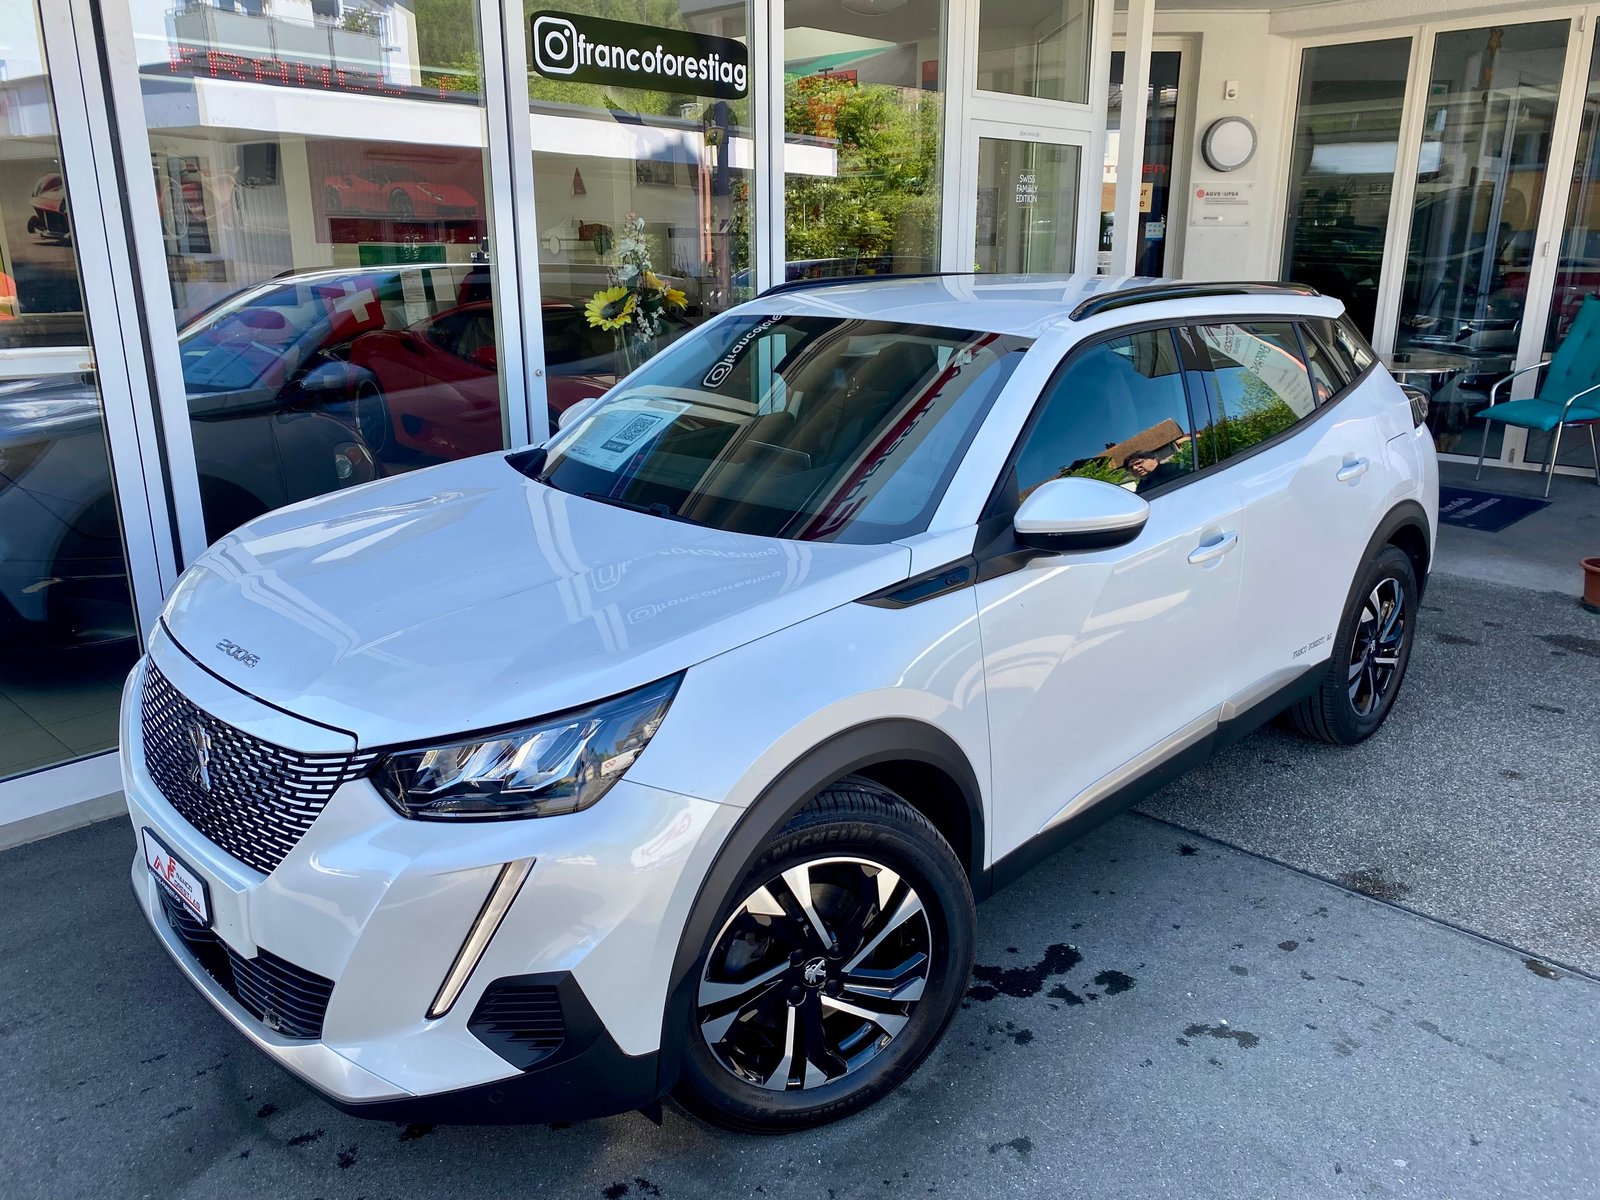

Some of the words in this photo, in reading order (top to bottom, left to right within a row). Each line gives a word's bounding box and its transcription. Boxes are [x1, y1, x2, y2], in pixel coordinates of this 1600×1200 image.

[578, 34, 746, 92] francoforestiag
[1019, 174, 1036, 183] SWISS
[1015, 194, 1038, 203] EDITION
[216, 638, 260, 669] 2008
[772, 829, 874, 858] MICHELIN
